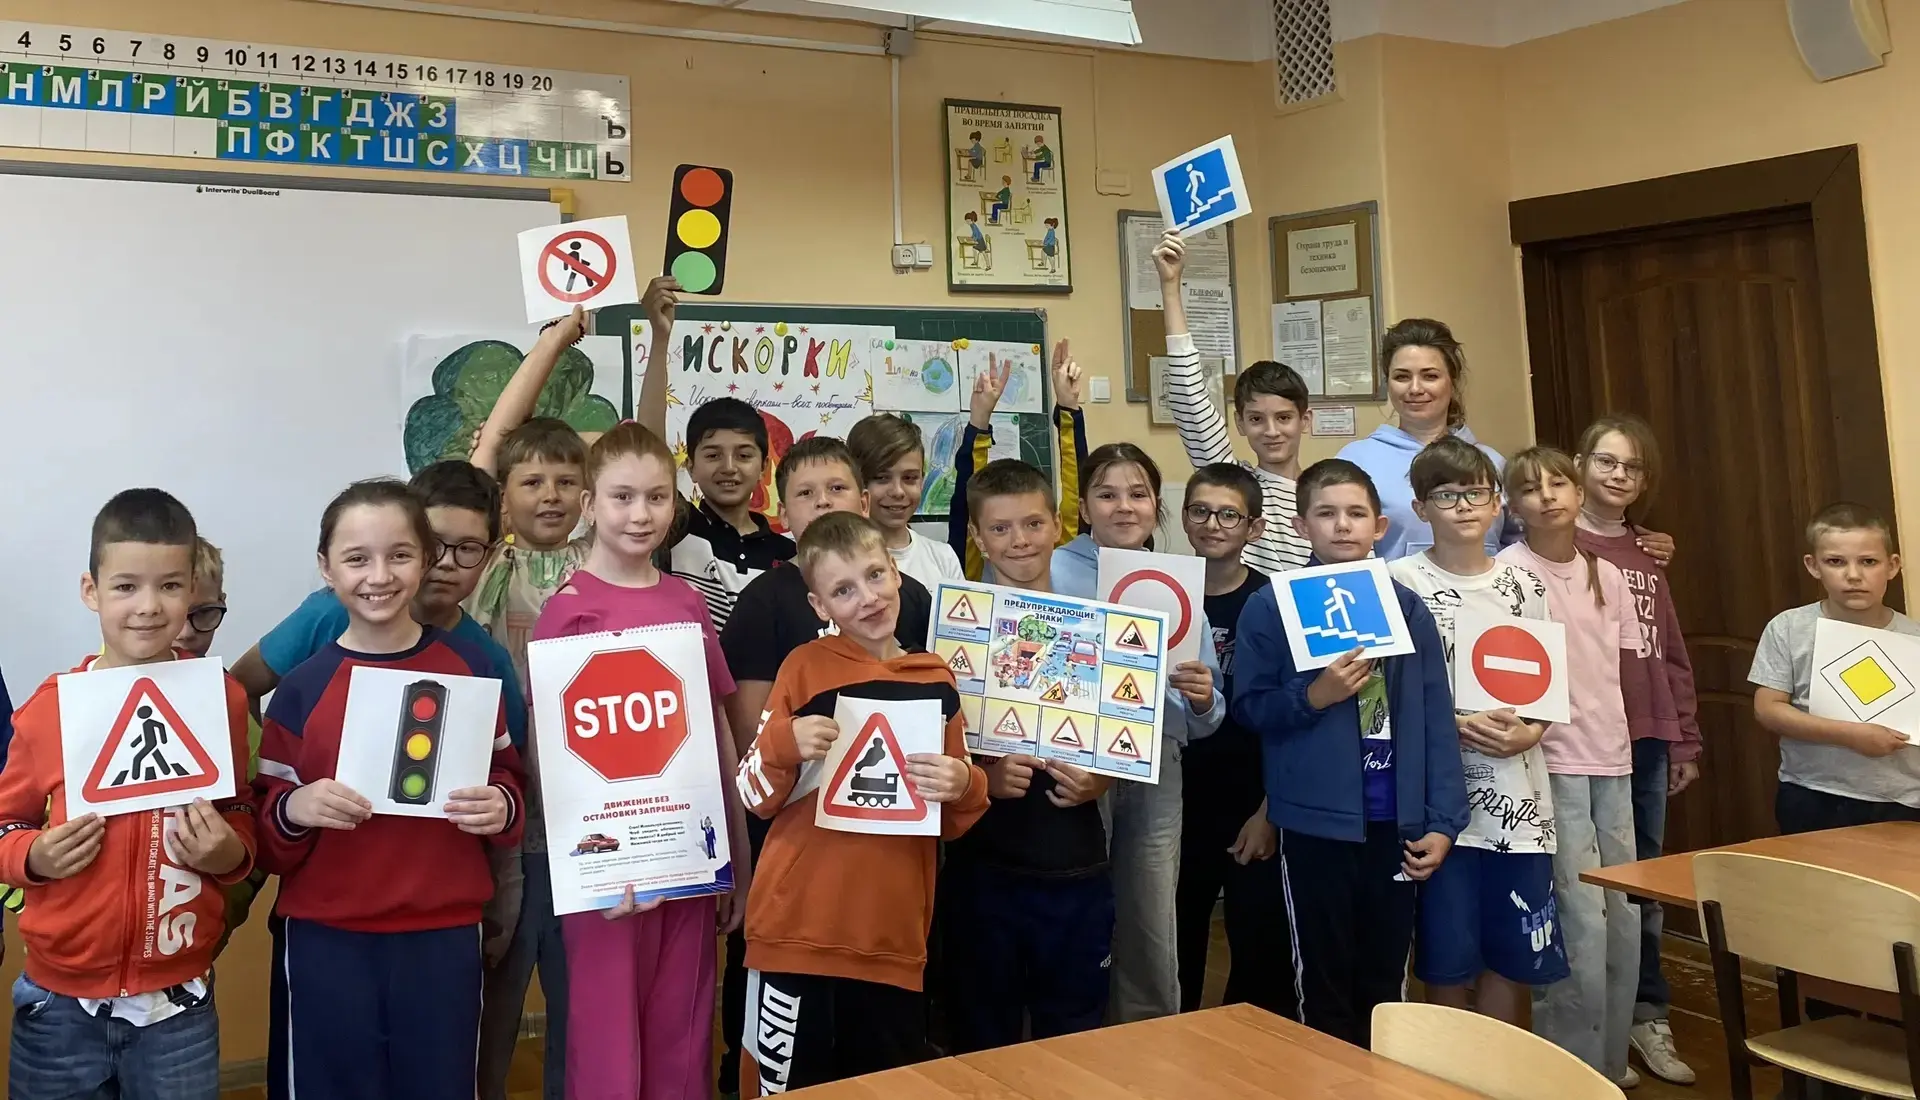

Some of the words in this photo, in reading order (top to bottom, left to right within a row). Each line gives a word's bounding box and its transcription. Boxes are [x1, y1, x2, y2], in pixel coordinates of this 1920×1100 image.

[18, 31, 31, 48] 4
[59, 35, 71, 51] 5
[93, 37, 105, 54] 6
[130, 40, 142, 57] 7
[163, 43, 175, 60] 8
[197, 46, 209, 62] 9
[225, 49, 247, 65] 10
[257, 52, 277, 68] 11
[292, 55, 315, 72] 12
[323, 57, 345, 74] 13
[354, 60, 377, 76] 14
[385, 63, 408, 79] 15
[416, 65, 438, 82] 16
[446, 68, 467, 84] 17
[474, 70, 495, 87] 18
[503, 73, 523, 89] 19
[532, 76, 553, 91] 20
[8, 72, 34, 101] Н
[52, 76, 81, 104] М
[97, 79, 123, 107] Л
[143, 82, 166, 109] Р
[186, 78, 209, 113] Й
[228, 89, 251, 116] Б
[270, 92, 292, 119] В
[313, 95, 332, 121] Г
[346, 98, 374, 127] Д
[384, 102, 415, 128] Ж
[954, 106, 1011, 118] ПРАВИЛЬНАЯ
[1013, 111, 1052, 121] ПОСАДКА
[962, 118, 973, 126] ВО
[975, 119, 1002, 129] ВРЕМЯ
[1005, 122, 1044, 131] ЗАНЯТИЙ
[228, 127, 250, 153] П
[266, 129, 295, 155] Ф
[312, 132, 331, 159] К
[350, 134, 371, 160] Т
[384, 137, 414, 163] Ш
[427, 140, 449, 165] С
[463, 142, 484, 168] Х
[499, 145, 521, 175] Ц
[538, 147, 556, 171] Ч
[566, 149, 594, 178] Щ
[605, 152, 624, 175] Ь
[205, 186, 240, 194] Interwrite
[242, 188, 280, 196] DualBoard
[1004, 599, 1096, 619] ПРЕДУПРЕЖДАЮЩИЕ
[1035, 613, 1062, 623] ЗНАКИ
[573, 690, 678, 739] STOP
[603, 797, 653, 810] ДВИЖЕНИЕ
[655, 795, 670, 803] БЕЗ
[583, 809, 637, 822] ОСТАНОВКИ
[639, 803, 691, 815] ЗАПРЕЩЕНО
